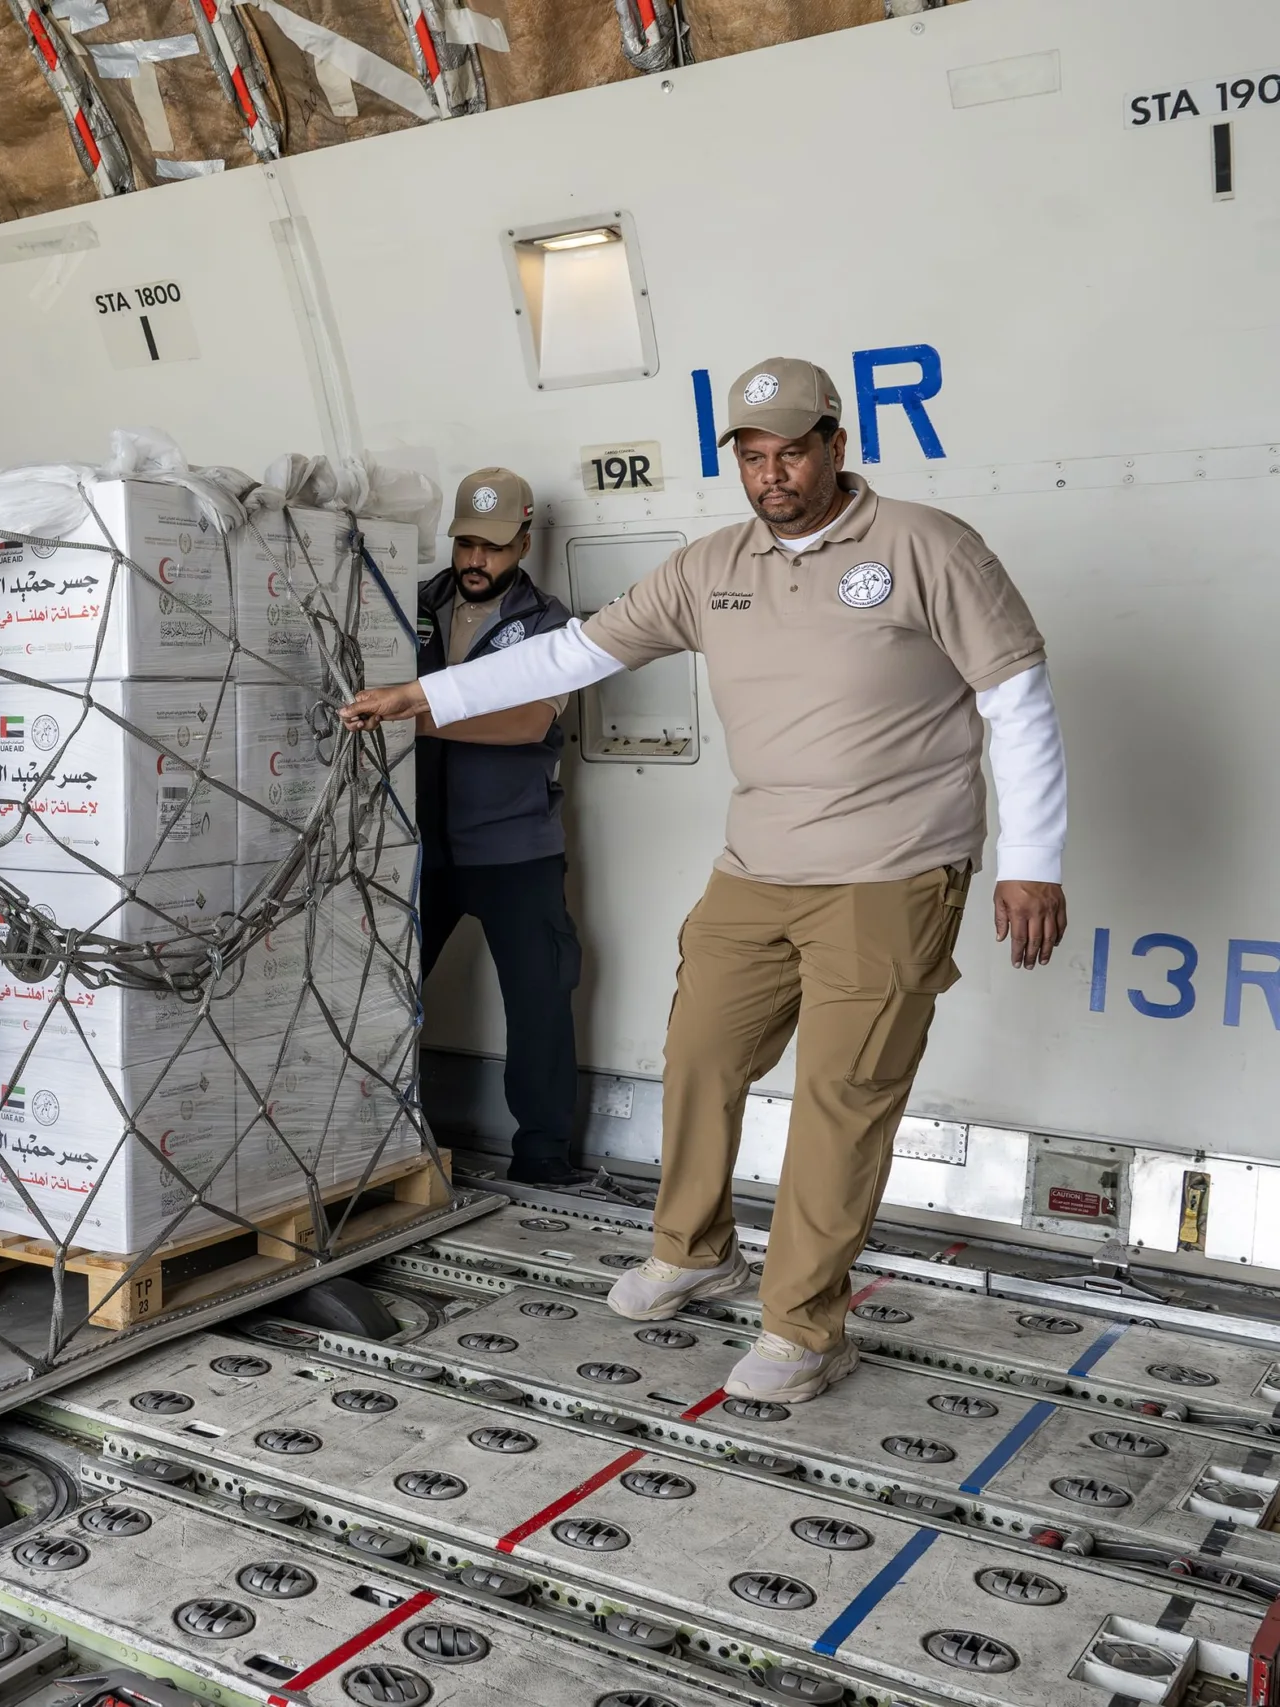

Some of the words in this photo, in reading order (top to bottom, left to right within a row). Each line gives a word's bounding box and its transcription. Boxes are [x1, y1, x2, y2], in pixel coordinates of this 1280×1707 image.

[1131, 88, 1200, 126] STA
[95, 292, 131, 314] STA
[134, 283, 181, 307] 1800
[691, 343, 946, 478] 1R
[591, 455, 653, 491] 19R
[12, 555, 23, 563] AID
[56, 575, 99, 595] جسر
[711, 599, 729, 610] UAE
[730, 599, 751, 610] AID
[56, 770, 98, 790] جسر
[1, 1113, 13, 1121] UAE
[13, 1114, 25, 1123] AID
[56, 1151, 99, 1171] جسر
[1052, 1190, 1081, 1200] CAUTION
[135, 1278, 153, 1298] TP
[138, 1299, 149, 1314] 23
